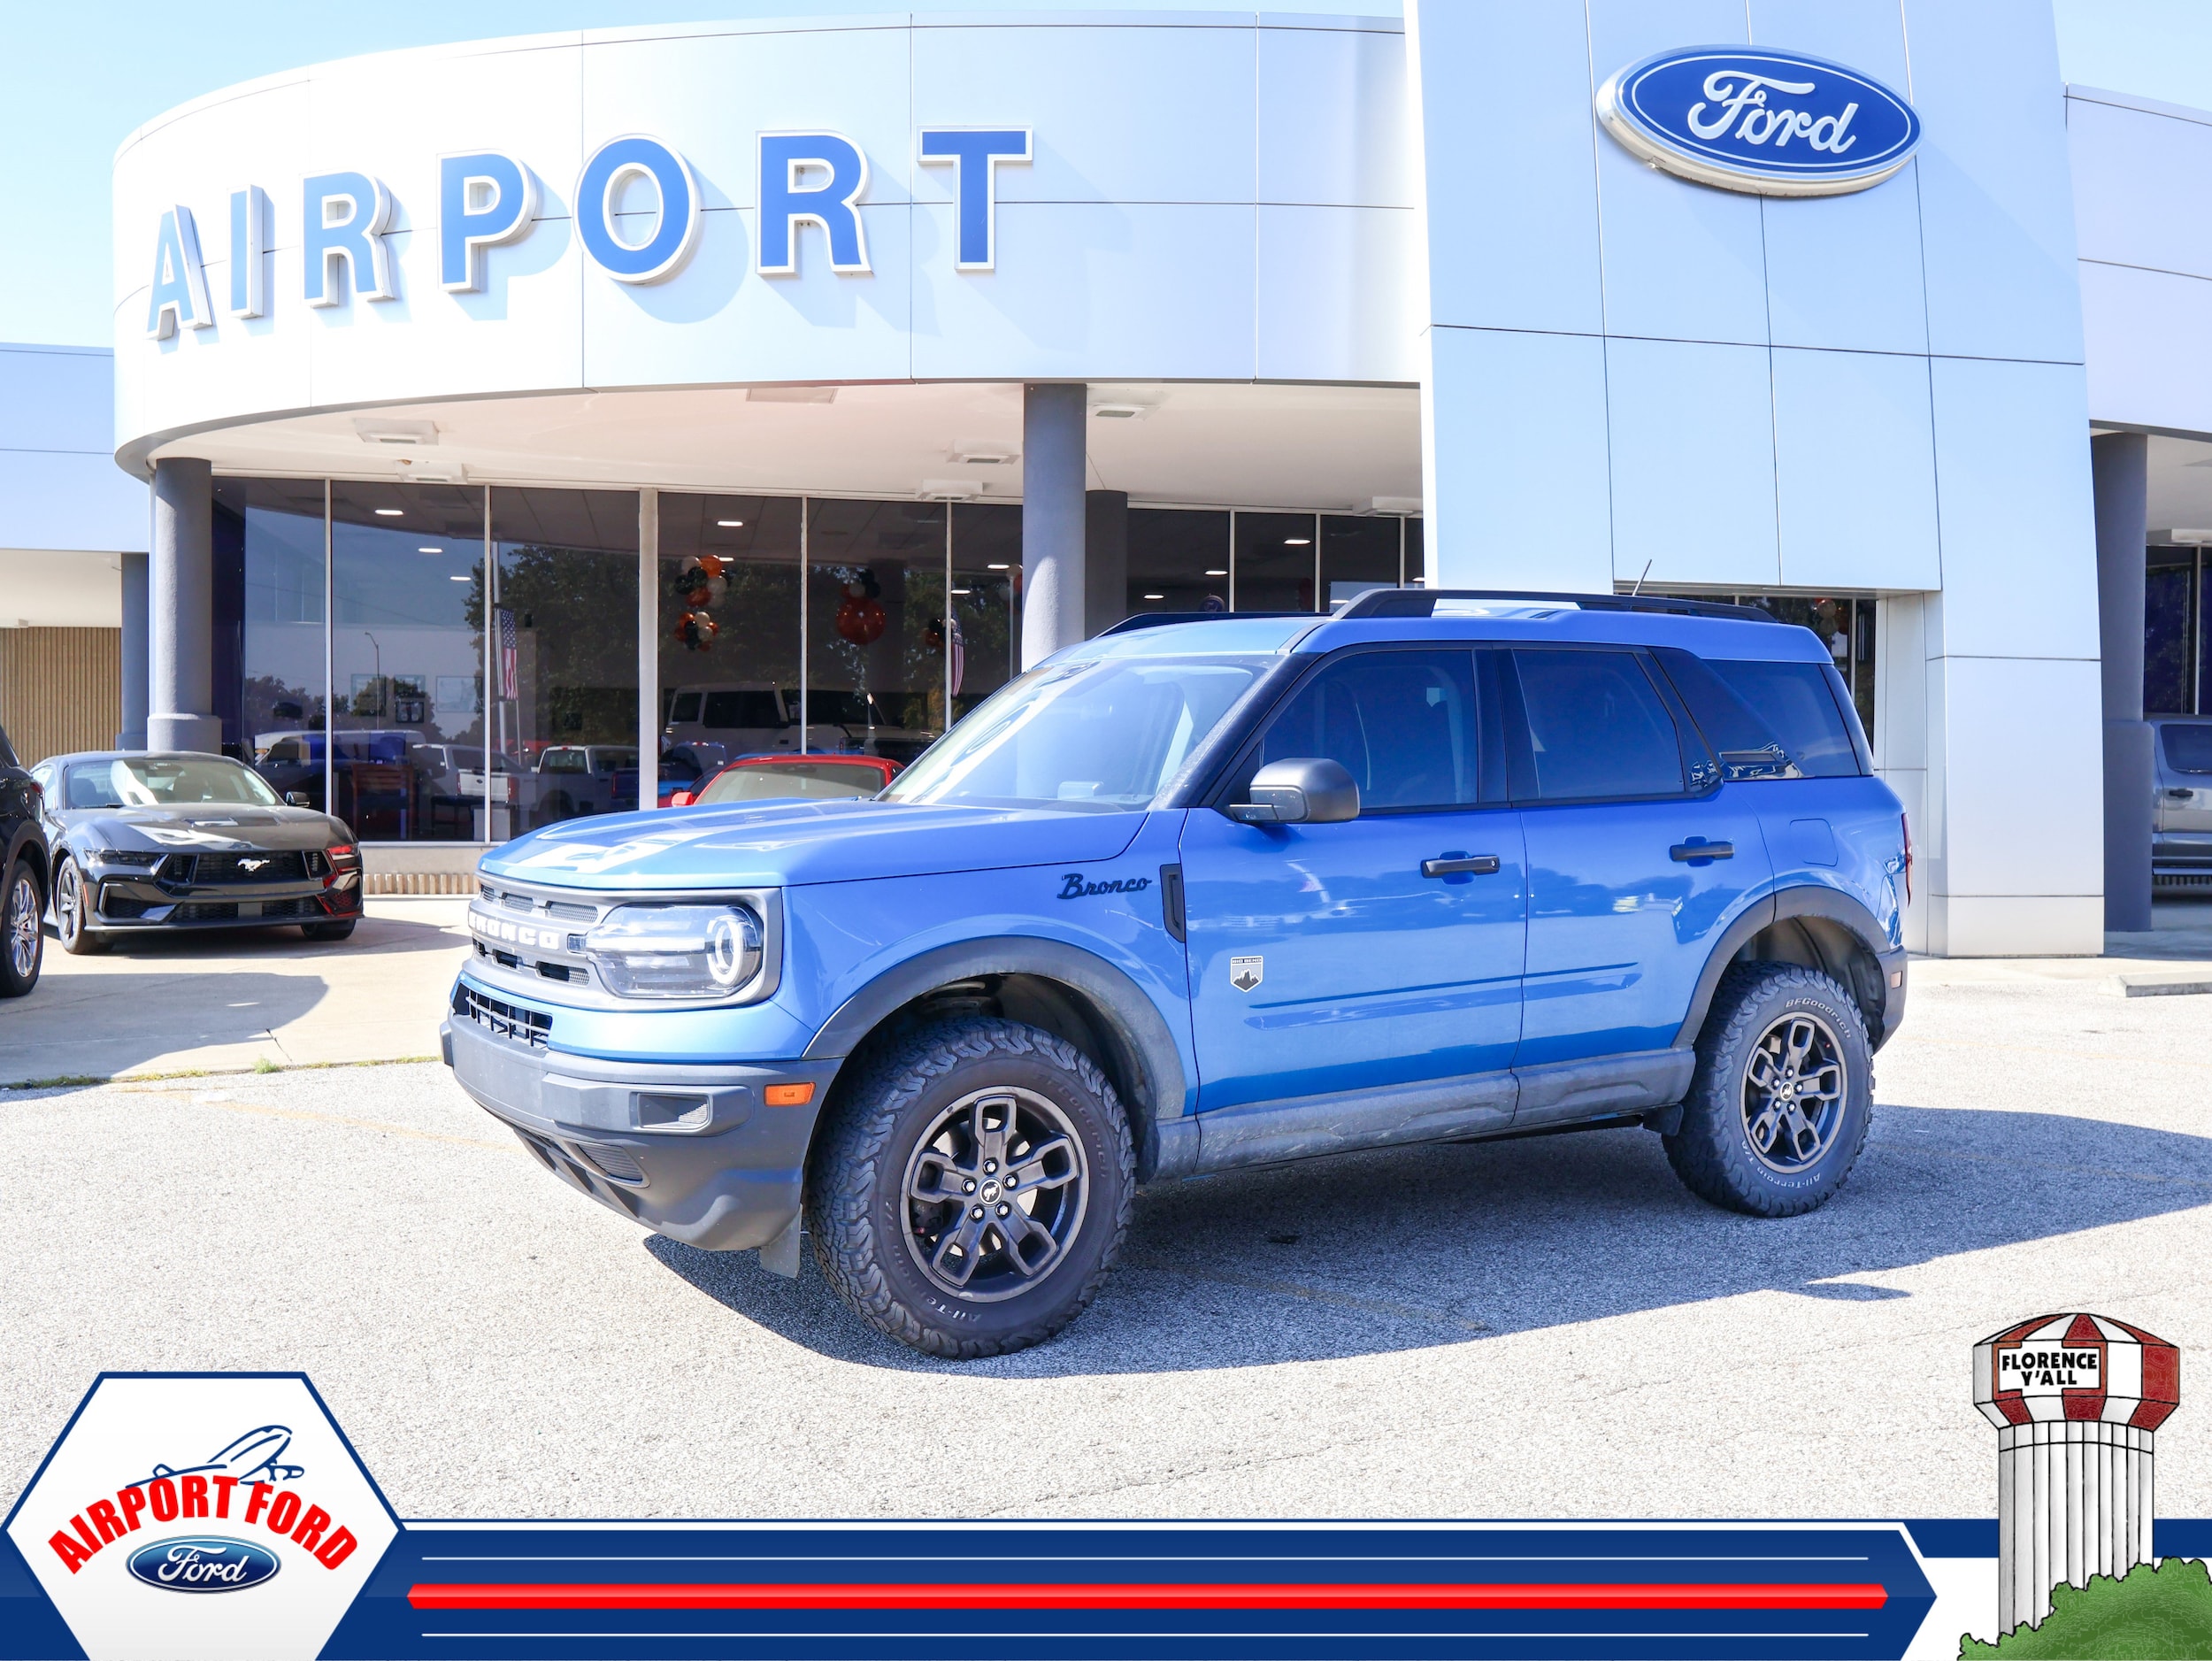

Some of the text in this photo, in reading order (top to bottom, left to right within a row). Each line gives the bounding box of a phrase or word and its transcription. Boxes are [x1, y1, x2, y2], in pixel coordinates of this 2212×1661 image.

[1686, 70, 1859, 154] Ford
[145, 125, 1033, 342] AIRPORT
[1056, 873, 1152, 900] Bronco
[1786, 997, 1852, 1039] BFGoodrich
